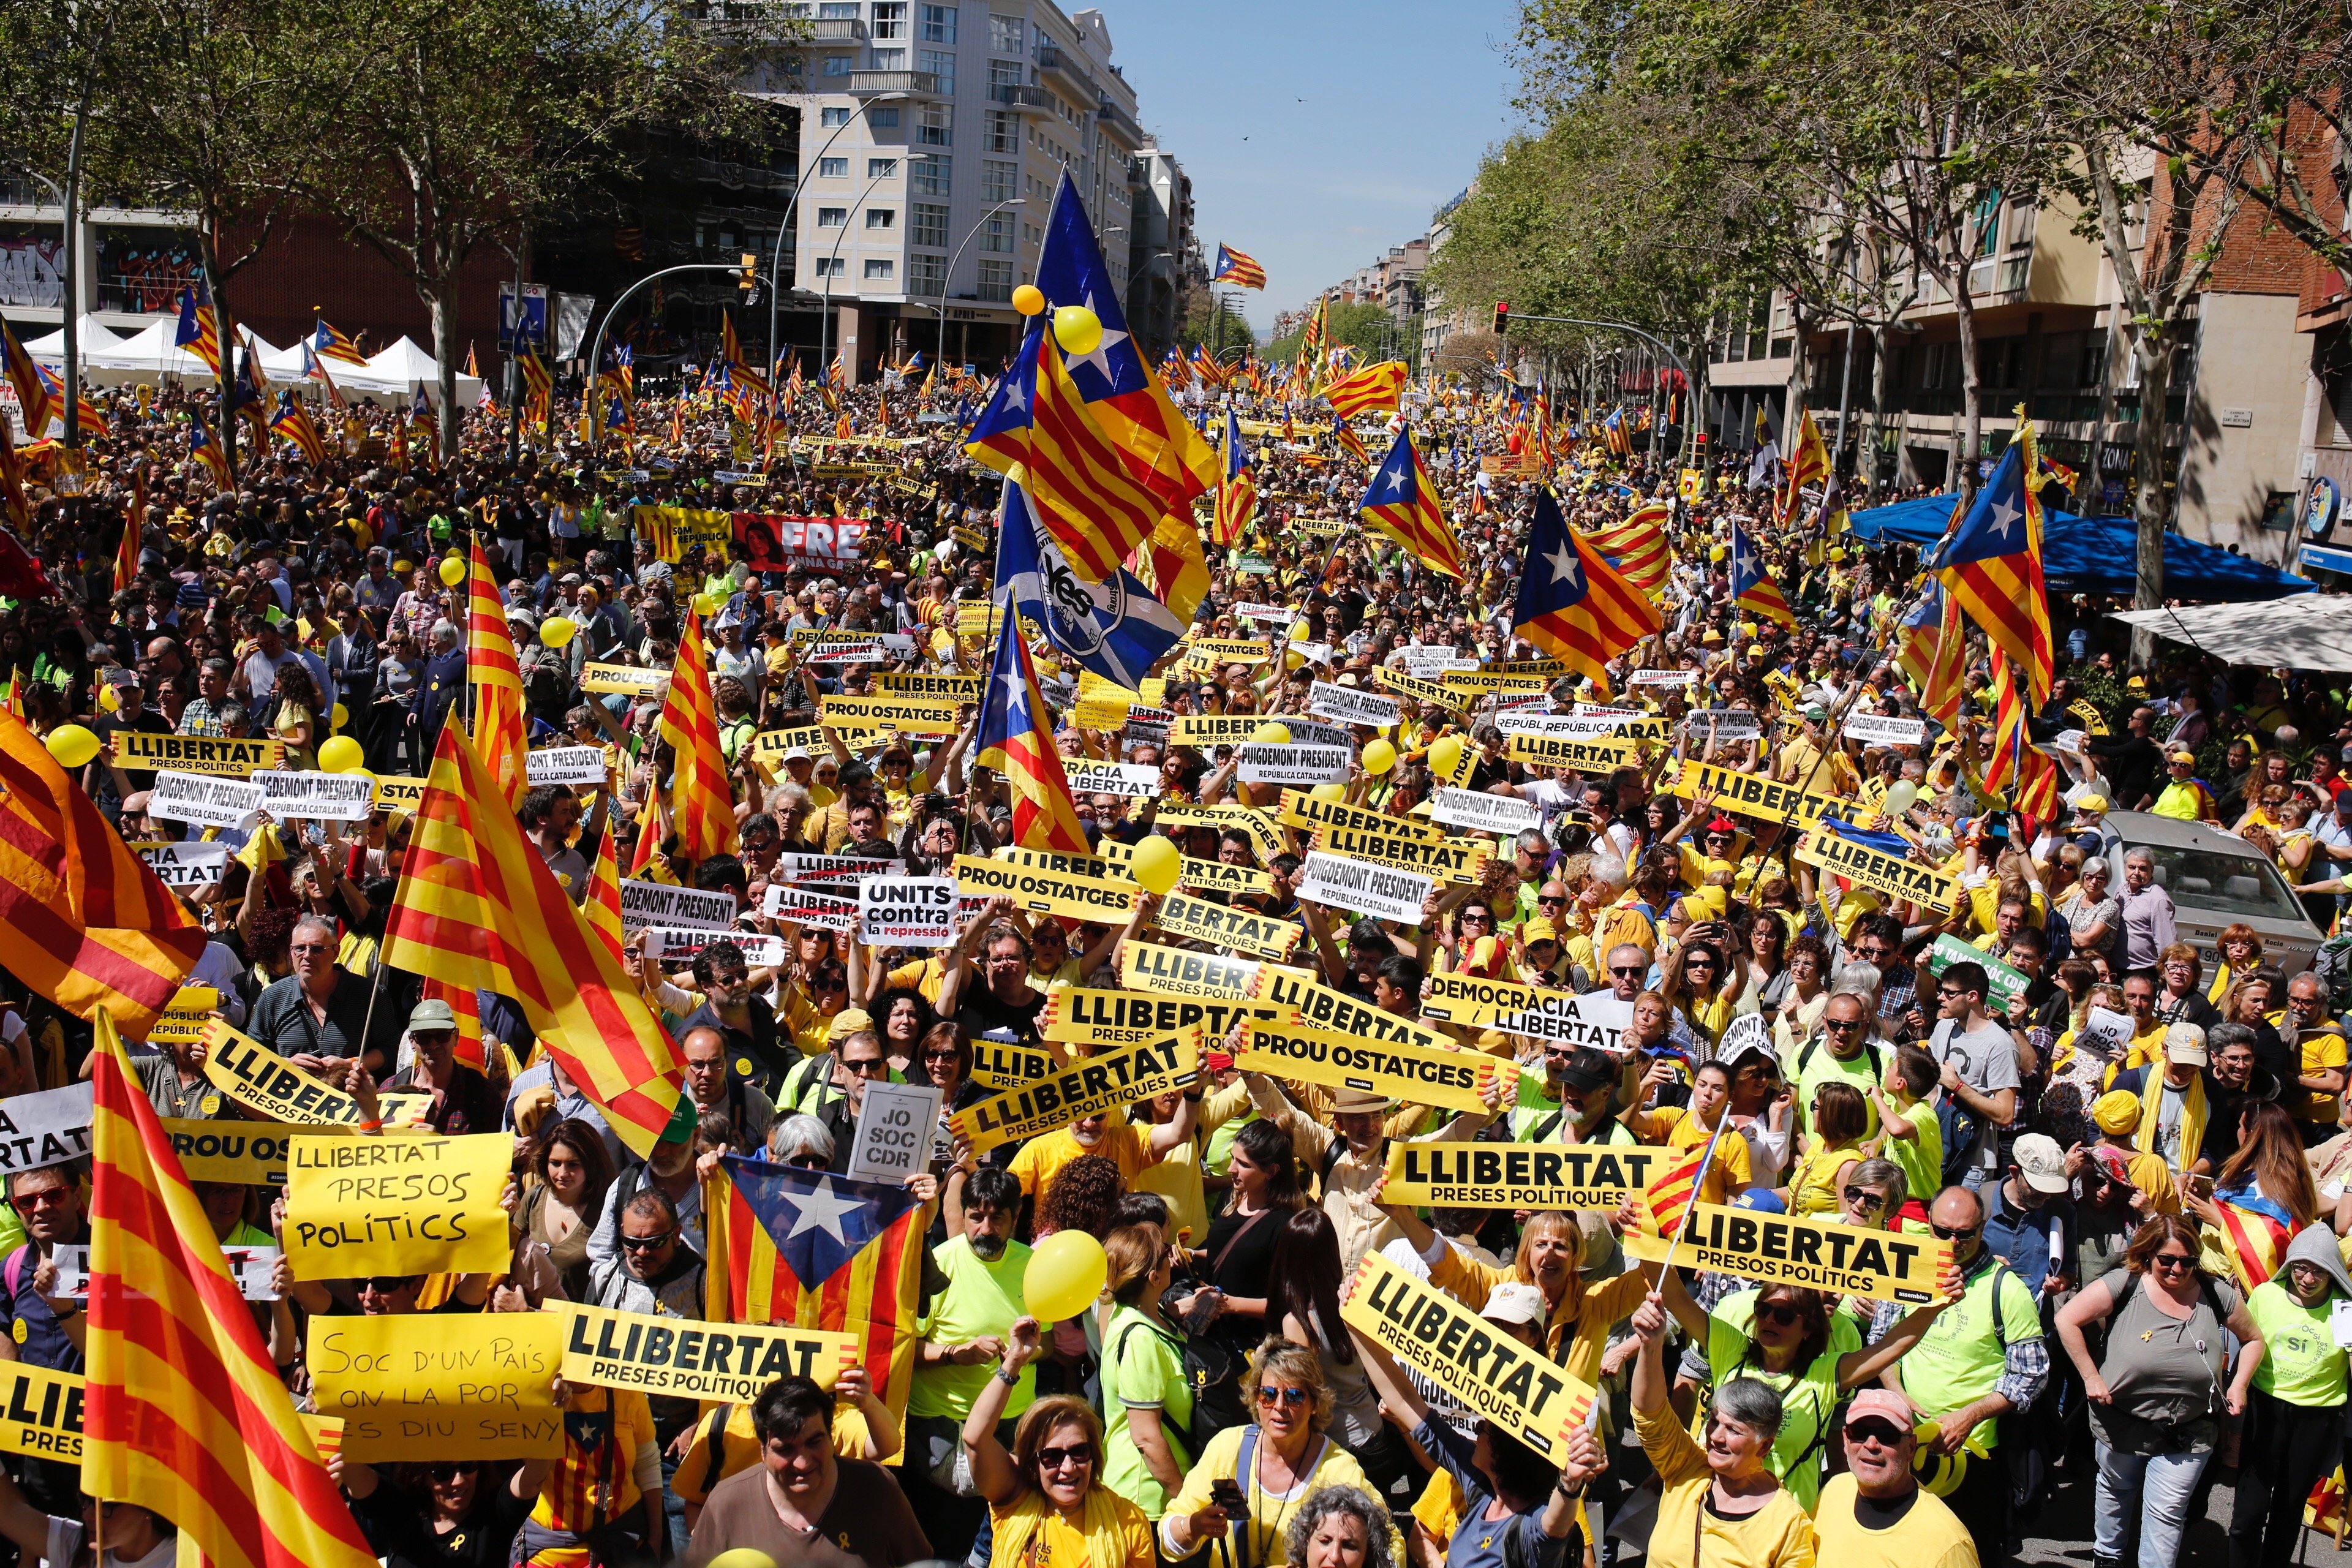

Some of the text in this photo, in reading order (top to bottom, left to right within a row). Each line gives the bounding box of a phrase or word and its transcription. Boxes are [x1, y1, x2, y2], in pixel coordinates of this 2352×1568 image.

[1660, 417, 1665, 431] P
[2102, 447, 2128, 471] ZONA
[673, 526, 692, 536] SOM
[1299, 519, 1344, 531] LLIBERTAT
[678, 531, 728, 544] REPÚBLICA
[786, 556, 824, 568] ANNA
[1044, 553, 1095, 618] Yes
[1106, 579, 1121, 614] Strong
[958, 613, 979, 622] HORITZÓ
[1242, 603, 1287, 617] LLIBERTAT
[1262, 614, 1284, 622] POLÍTICS!
[796, 631, 885, 646] DEMOCRÀCIA
[813, 643, 874, 657] LLIBERTAT
[1212, 643, 1269, 656] OSTATGES
[1428, 647, 1453, 659] PRESIDENT
[1409, 658, 1479, 669] PUIGDEMONT PRESIDENT
[592, 670, 630, 683] PROU
[883, 675, 982, 693] LLIBERTAT
[1447, 676, 1541, 689] PROU OSTATGES
[894, 691, 974, 702] PRESES POLÍTIQUES
[1383, 669, 1467, 707] LLIBERTAT
[1392, 682, 1458, 710] PRESES POLÍTIQUES
[825, 702, 952, 722] PROU OSTATGES
[1313, 685, 1398, 719] PUIGDEMONT PRESIDENT
[1583, 706, 1640, 717] LLIBERTAT
[1324, 707, 1383, 725] REPÚBLICA CATALANA
[1727, 713, 1757, 727] PRESIDENT
[1545, 720, 1612, 733] REPÚBLICA
[1613, 720, 1671, 741] ARA!
[1849, 716, 1921, 737] PUIGDEMONT PRESIDENT
[1858, 731, 1880, 739] REPÚBLICA
[127, 736, 265, 763] LLIBERTAT
[552, 748, 602, 767] PRESIDENT
[1242, 748, 1348, 771] PUIGDEMONT PRESIDENT
[1516, 737, 1626, 765] LLIBERTAT
[149, 758, 243, 772] PRESOS POLÍTICS
[1532, 755, 1607, 771] PRESOS POLÍTICS
[550, 770, 588, 780] CATALANA
[1259, 769, 1331, 781] REPÚBLICA CATALANA
[154, 775, 261, 811] PUIGDEMONT PRESIDENT
[316, 780, 369, 802] PRESIDENT
[1698, 767, 1863, 826] LLIBERTAT
[167, 804, 237, 823] REPÚBLICA CATALANA
[266, 802, 348, 815] REPÚBLICA CATALANA
[1439, 791, 1488, 817] PUIGDEMONT
[1491, 799, 1537, 822] PRESIDENT
[1452, 813, 1520, 831] REPÚBLICA CATALANA
[1330, 831, 1469, 870] LLIBERTAT
[796, 856, 889, 875] LLIBERTAT
[1395, 859, 1444, 876] POLÍTICS
[1815, 835, 1951, 899] LLIBERTAT
[796, 872, 836, 883] PRESOS
[958, 865, 1129, 910] PROU OSTATGES
[1306, 856, 1427, 905] PUIGDEMONT PRESIDENT
[1824, 860, 1929, 903] PRESES POLÍTIQUES
[868, 885, 951, 905] UNITS
[1321, 887, 1403, 917] REPÚBLICA CATALANA
[675, 894, 734, 924] PRESIDENT
[775, 908, 818, 921] PRESOS
[867, 907, 949, 925] contra
[868, 923, 949, 938] la repressió
[1184, 924, 1257, 950] POLÍTIQUES
[1150, 978, 1200, 995] PRESES
[1984, 965, 2026, 992] SÓC CDR
[1431, 977, 1580, 1020] DEMOCRÀCIA
[1472, 1006, 1621, 1046] i LLIBERTAT
[2100, 1025, 2117, 1037] JO
[2089, 1033, 2117, 1049] SOC
[1253, 1031, 1474, 1089] PROU OSTATGES
[975, 1037, 1179, 1134] LLIBERTAT
[235, 1081, 300, 1119] PRESOS
[1005, 1076, 1168, 1137] PRESES POLÍTIQUES
[881, 1108, 912, 1126] JO
[869, 1128, 917, 1147] SOC
[296, 1140, 451, 1169] LLIBERTAT
[865, 1147, 911, 1168] CDR
[1405, 1150, 1652, 1188] LLIBERTAT
[327, 1172, 472, 1202] PRESOS
[1431, 1186, 1624, 1207] PRESES POLÍTIQUES
[1696, 1249, 1874, 1292] PRESOS POLÍTICS
[1898, 1292, 1929, 1302] assemblea
[318, 1332, 545, 1374] SOC D'UN PAÍS
[568, 1314, 823, 1380] LLIBERTAT
[1367, 1270, 1564, 1417] LLIBERTAT
[2288, 1336, 2309, 1353] Sí
[591, 1361, 671, 1386] PRESES
[1378, 1321, 1433, 1368] PRESES
[1433, 1353, 1523, 1428] POLÍTIQUES
[341, 1383, 521, 1411] ON LA POR
[399, 1419, 454, 1438] DIU
[480, 1419, 559, 1442] SENY
